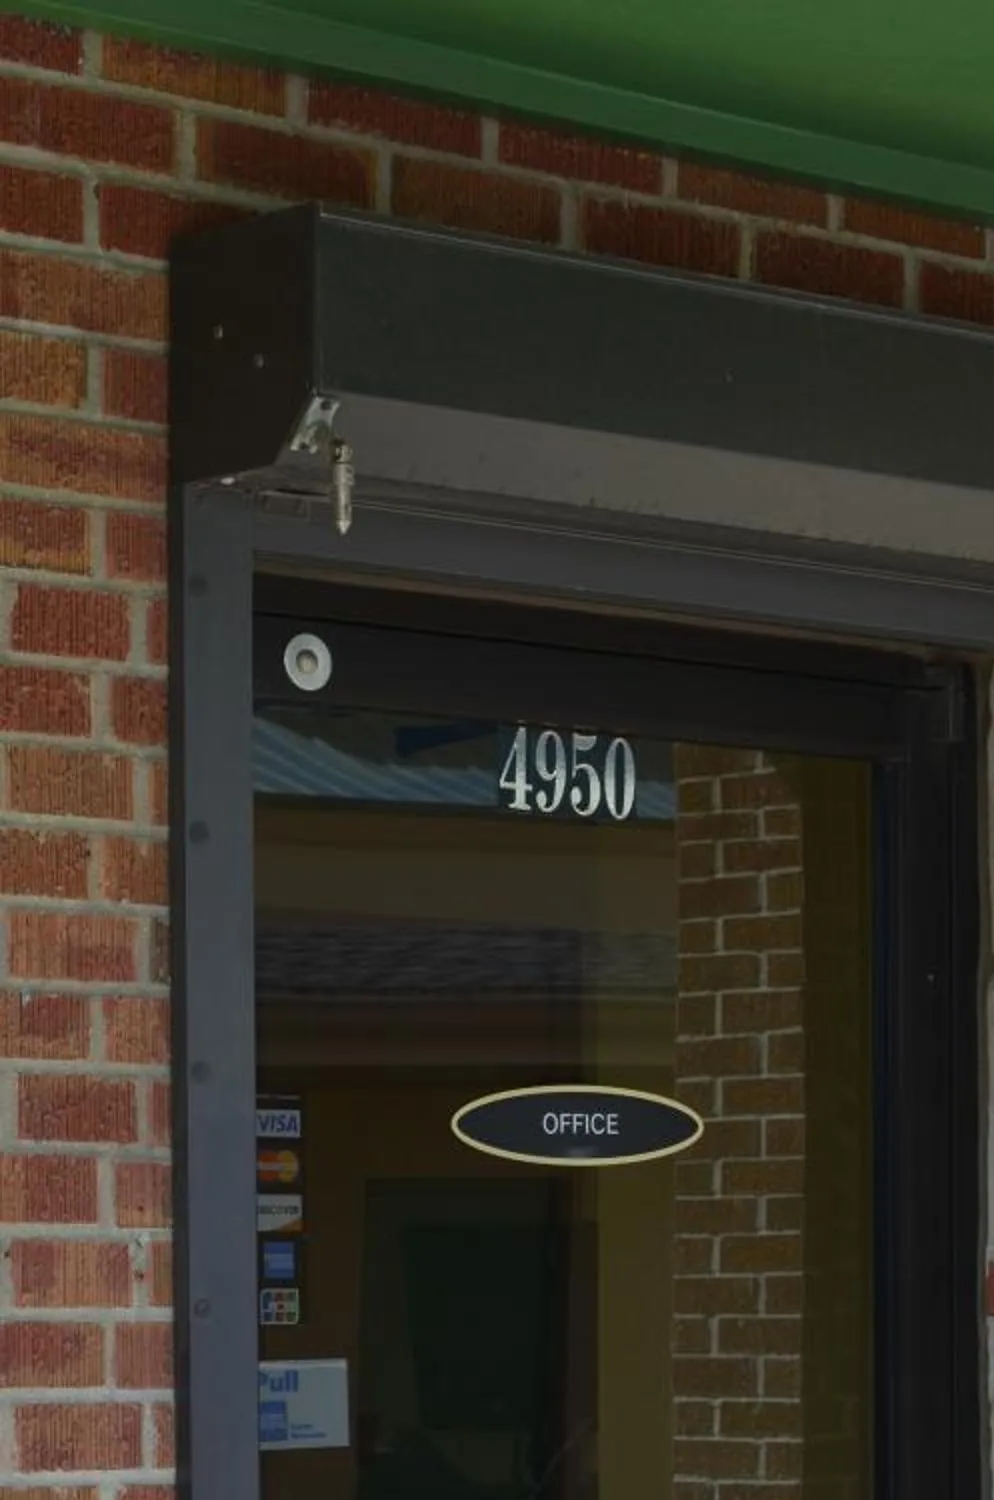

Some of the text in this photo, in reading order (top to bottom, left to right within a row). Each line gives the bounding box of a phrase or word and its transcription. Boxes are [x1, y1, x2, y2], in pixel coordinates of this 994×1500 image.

[500, 725, 635, 820] 4950
[258, 1114, 298, 1132] VISA
[543, 1112, 620, 1135] OFFICE
